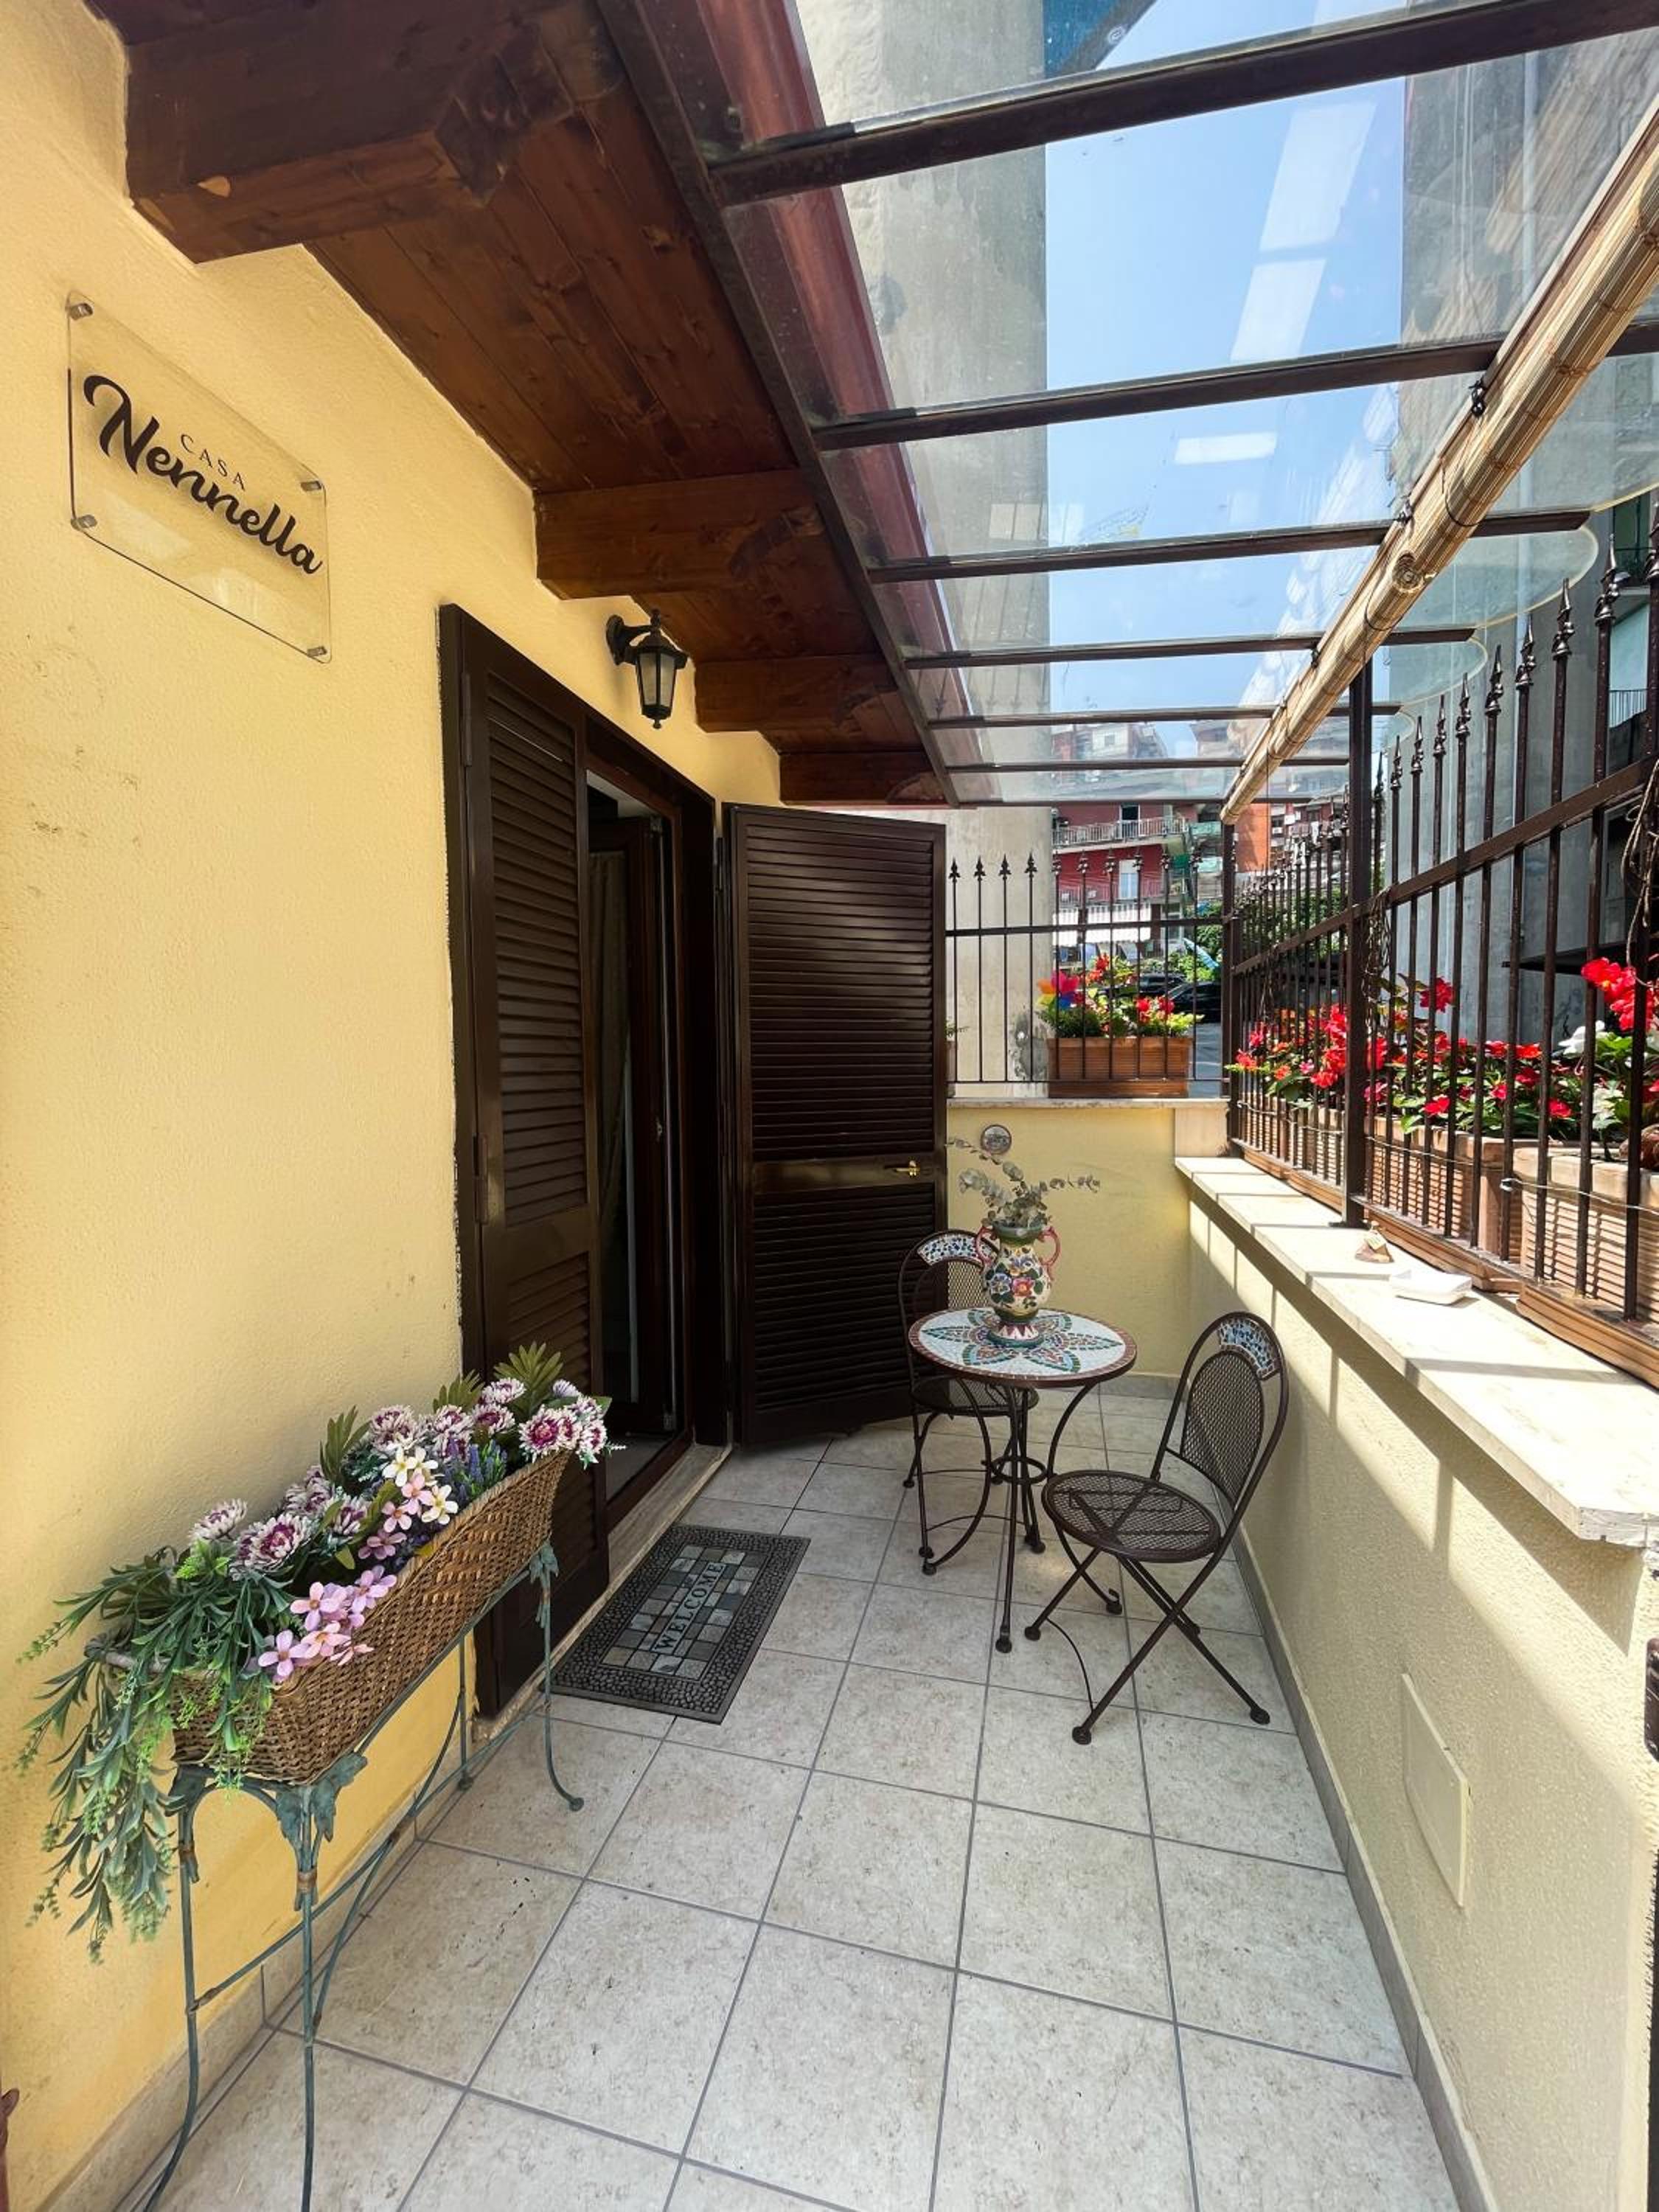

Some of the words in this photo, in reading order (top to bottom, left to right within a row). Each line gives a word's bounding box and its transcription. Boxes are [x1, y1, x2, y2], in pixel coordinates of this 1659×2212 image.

[83, 375, 323, 574] Nennella
[180, 434, 246, 492] CASA
[655, 1564, 724, 1651] WELCOME
